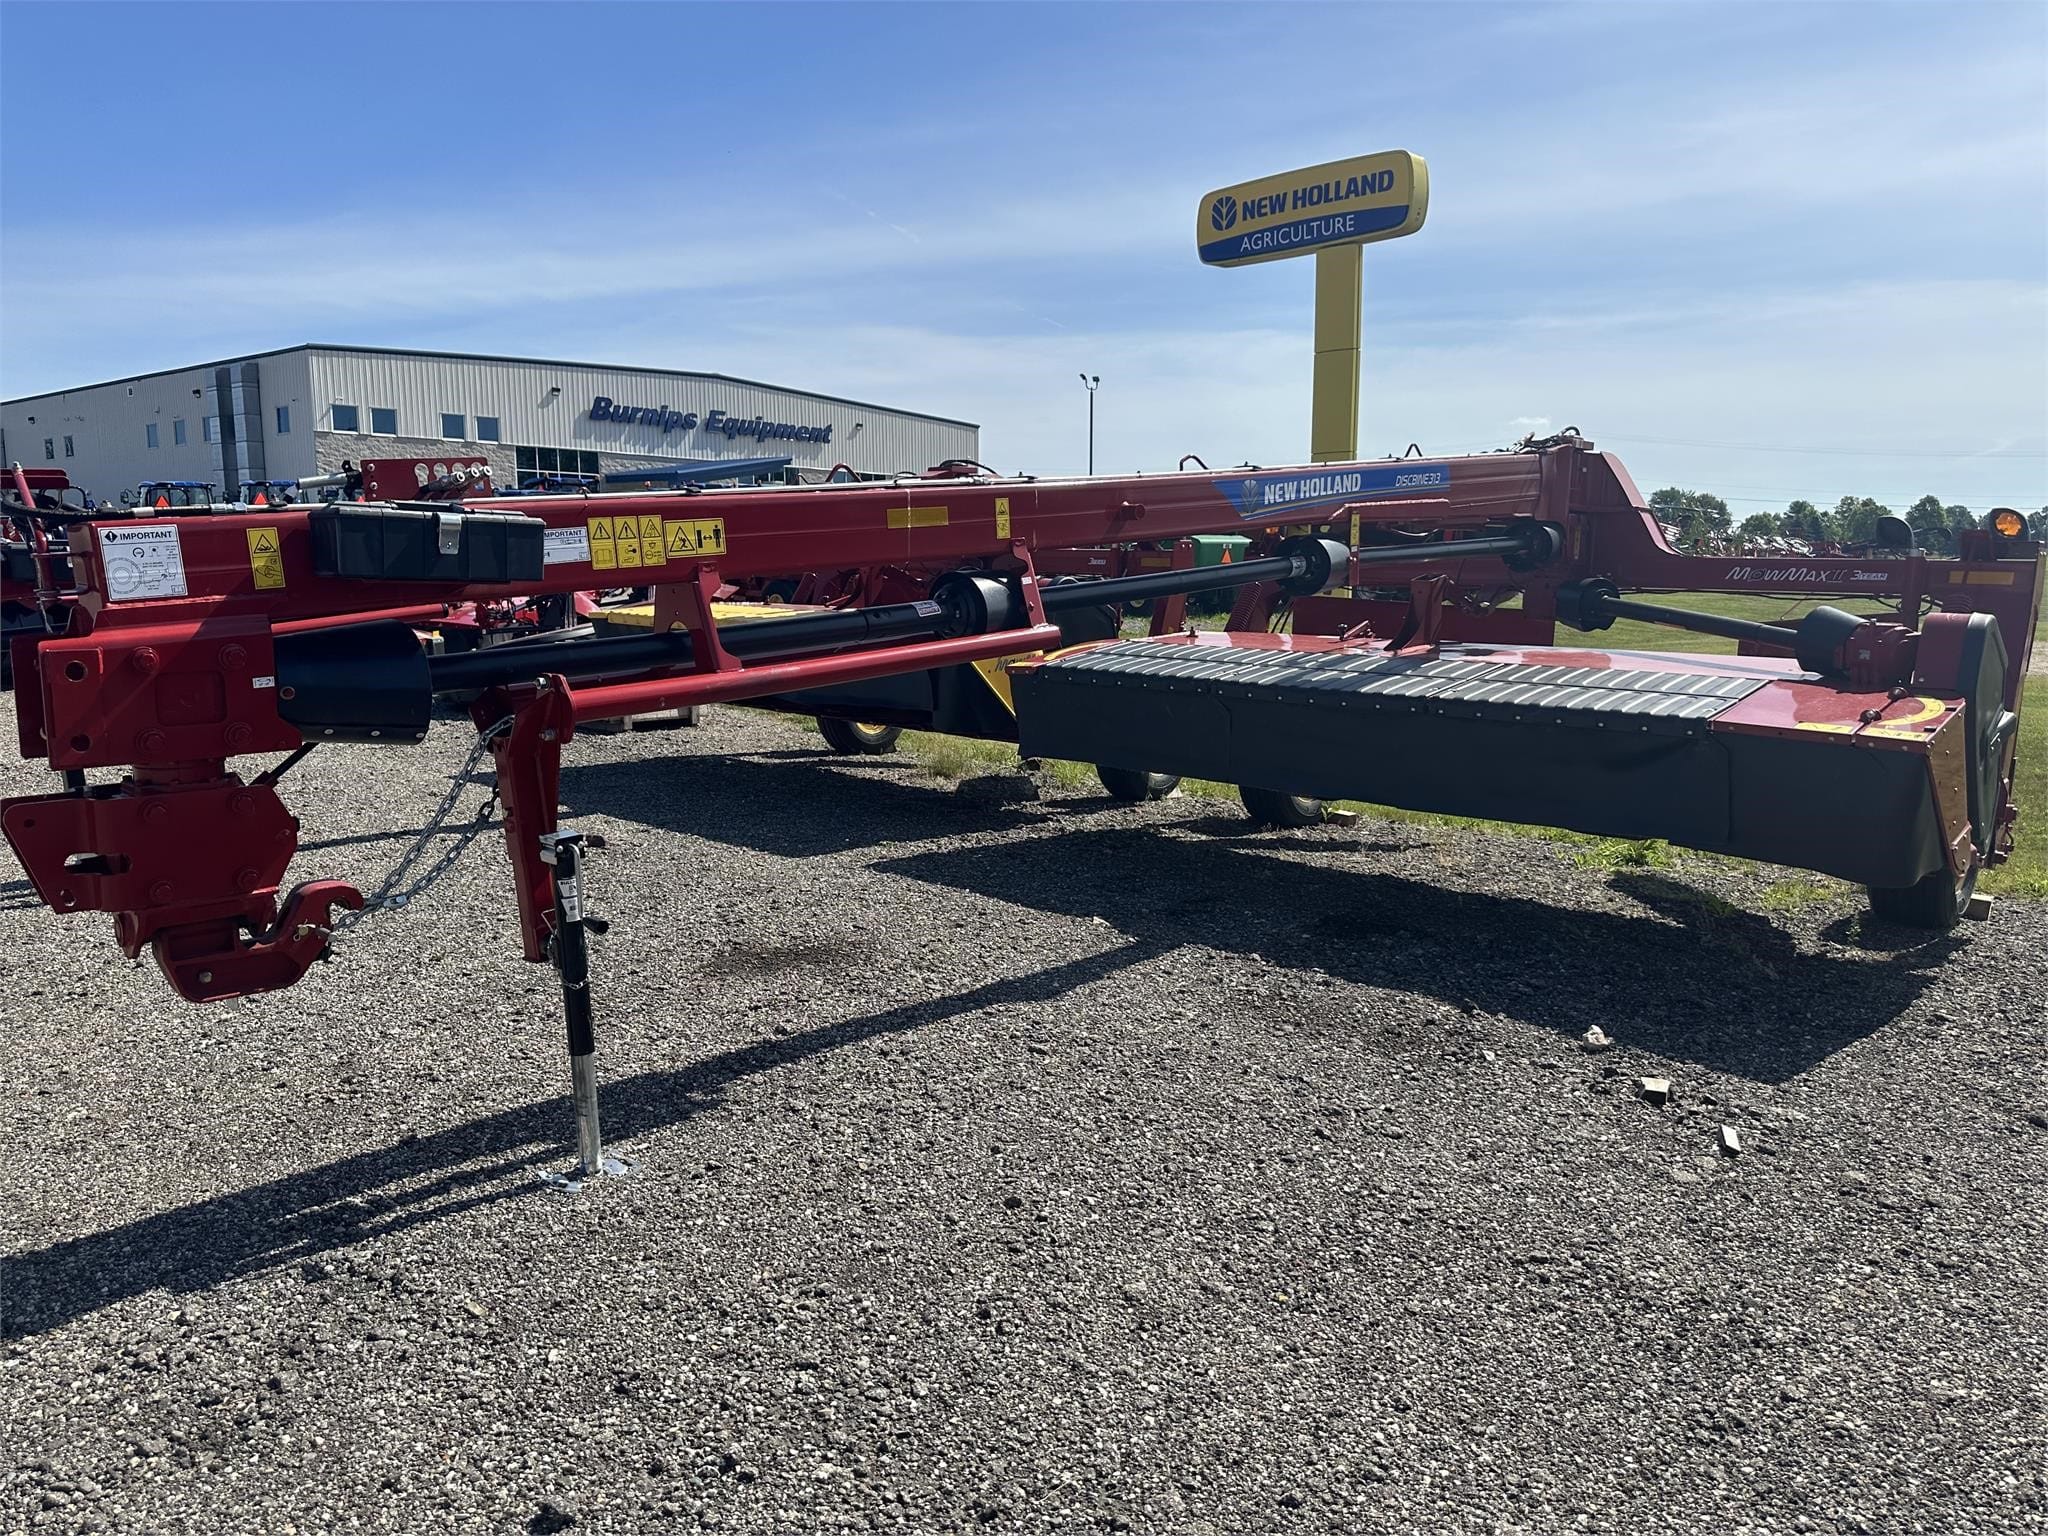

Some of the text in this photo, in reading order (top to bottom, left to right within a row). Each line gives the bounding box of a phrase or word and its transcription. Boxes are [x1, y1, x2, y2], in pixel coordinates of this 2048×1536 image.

[1242, 169, 1394, 221] NEW HOLLAND
[1240, 214, 1355, 252] AGRICULTURE
[589, 396, 832, 444] Burnips Equipment
[1264, 473, 1361, 505] NEW HOLLAND
[120, 531, 172, 540] IMPORTANT
[544, 530, 582, 538] MPORTANT
